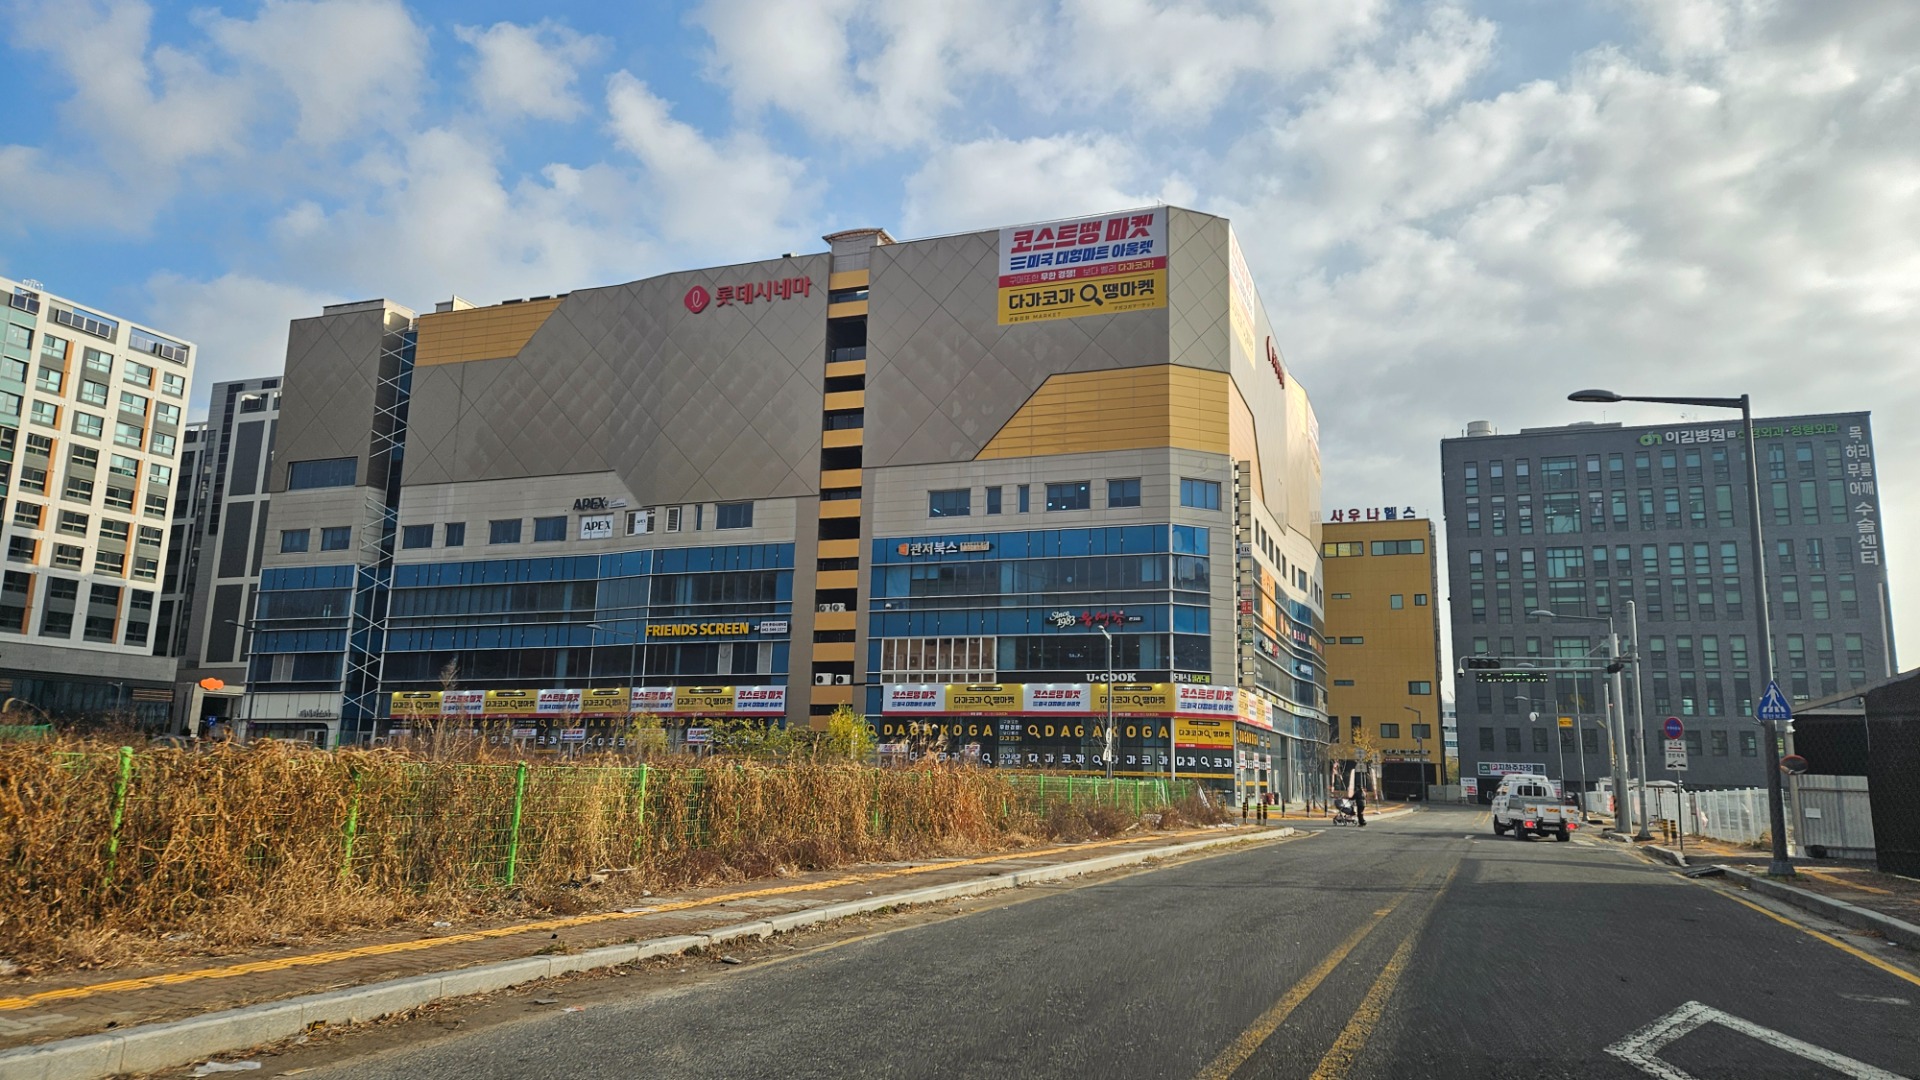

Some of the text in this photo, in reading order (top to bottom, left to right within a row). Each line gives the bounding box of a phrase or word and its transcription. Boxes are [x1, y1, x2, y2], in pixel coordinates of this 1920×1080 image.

[1011, 213, 1154, 254] 코스트땡 마켓
[1027, 240, 1153, 268] 미국 대형마트 아울렛
[1040, 272, 1056, 281] 무한
[1118, 260, 1154, 272] 다가코가!
[715, 276, 812, 307] 롯데시네마
[1009, 279, 1154, 310] 다가코가 땡마켓
[1665, 428, 1725, 444] 이김병원
[573, 497, 606, 511] APEX
[1330, 506, 1415, 522] 사우나헬스
[584, 520, 611, 531] APEX
[1854, 502, 1879, 565] 수술센터
[910, 542, 958, 556] 관저북스
[646, 624, 698, 637] FRIENDS
[699, 622, 749, 636] SCREEN
[1057, 616, 1076, 628] 1983
[953, 696, 982, 704] 다가코가
[1033, 690, 1081, 699] 코스트땡 마켓
[1181, 688, 1233, 701] 코스트땡 마켓
[1499, 764, 1532, 772] 지하주차장
